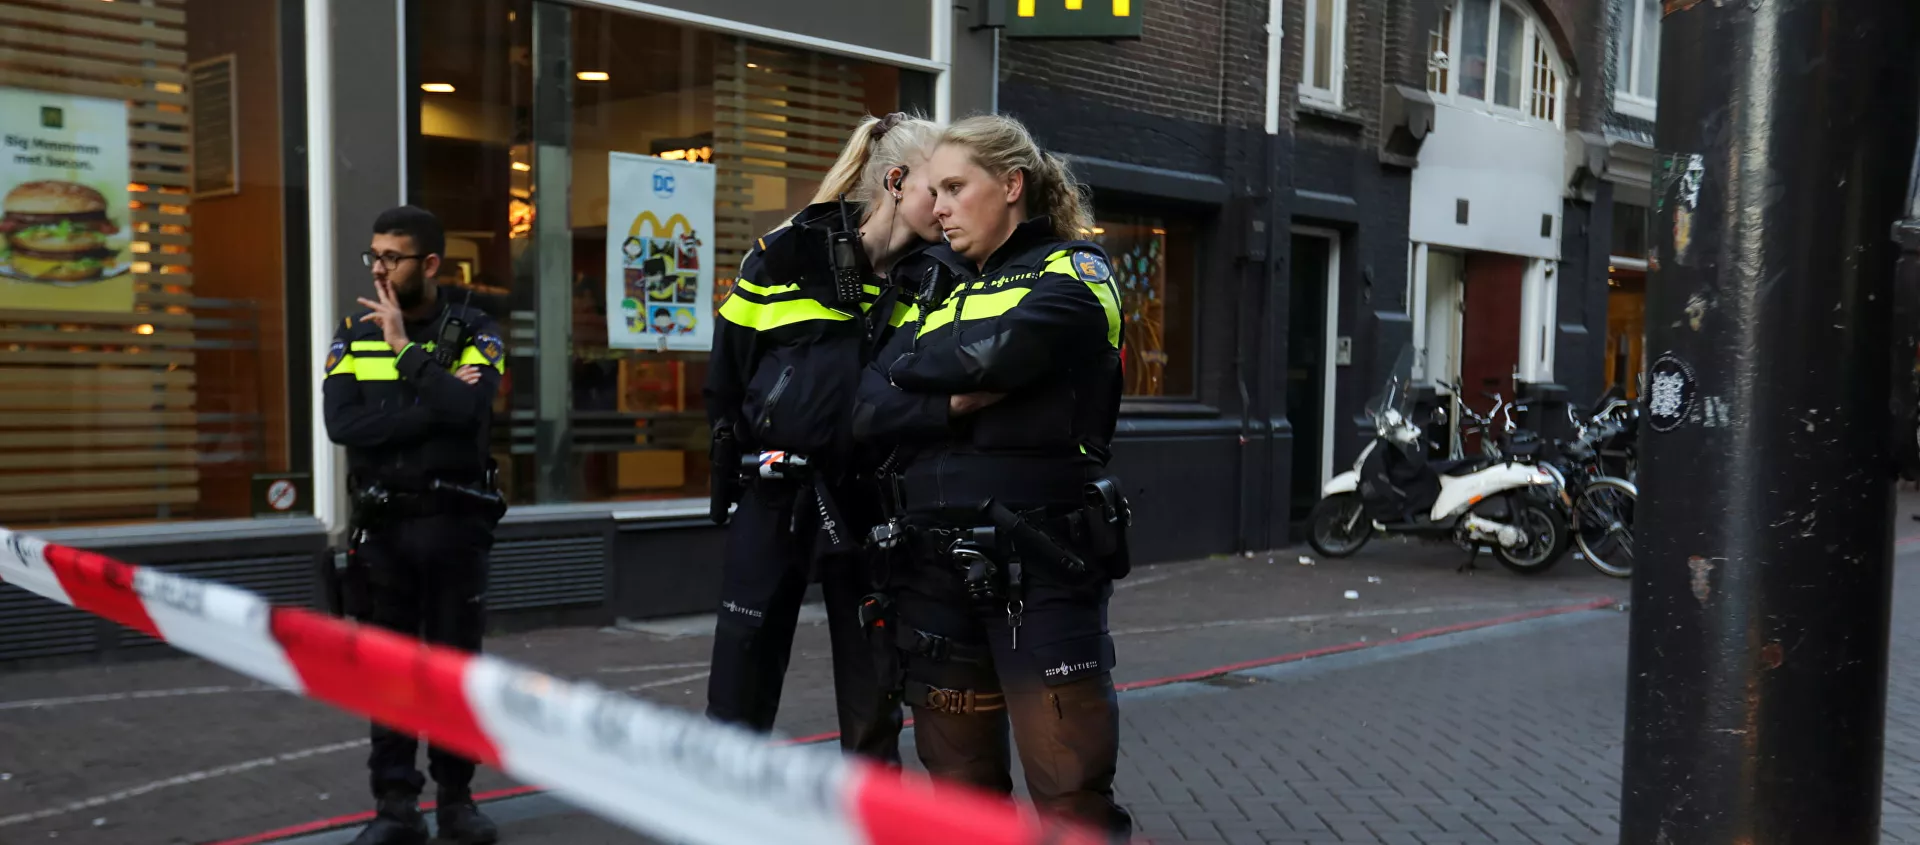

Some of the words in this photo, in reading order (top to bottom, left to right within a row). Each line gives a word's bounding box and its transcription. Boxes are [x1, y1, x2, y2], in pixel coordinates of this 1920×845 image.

[4, 134, 28, 151] Big
[13, 153, 42, 164] met
[653, 174, 675, 192] DC
[991, 272, 1032, 288] POLITIE
[726, 600, 754, 616] POLITIE
[1055, 661, 1090, 676] POLITIE
